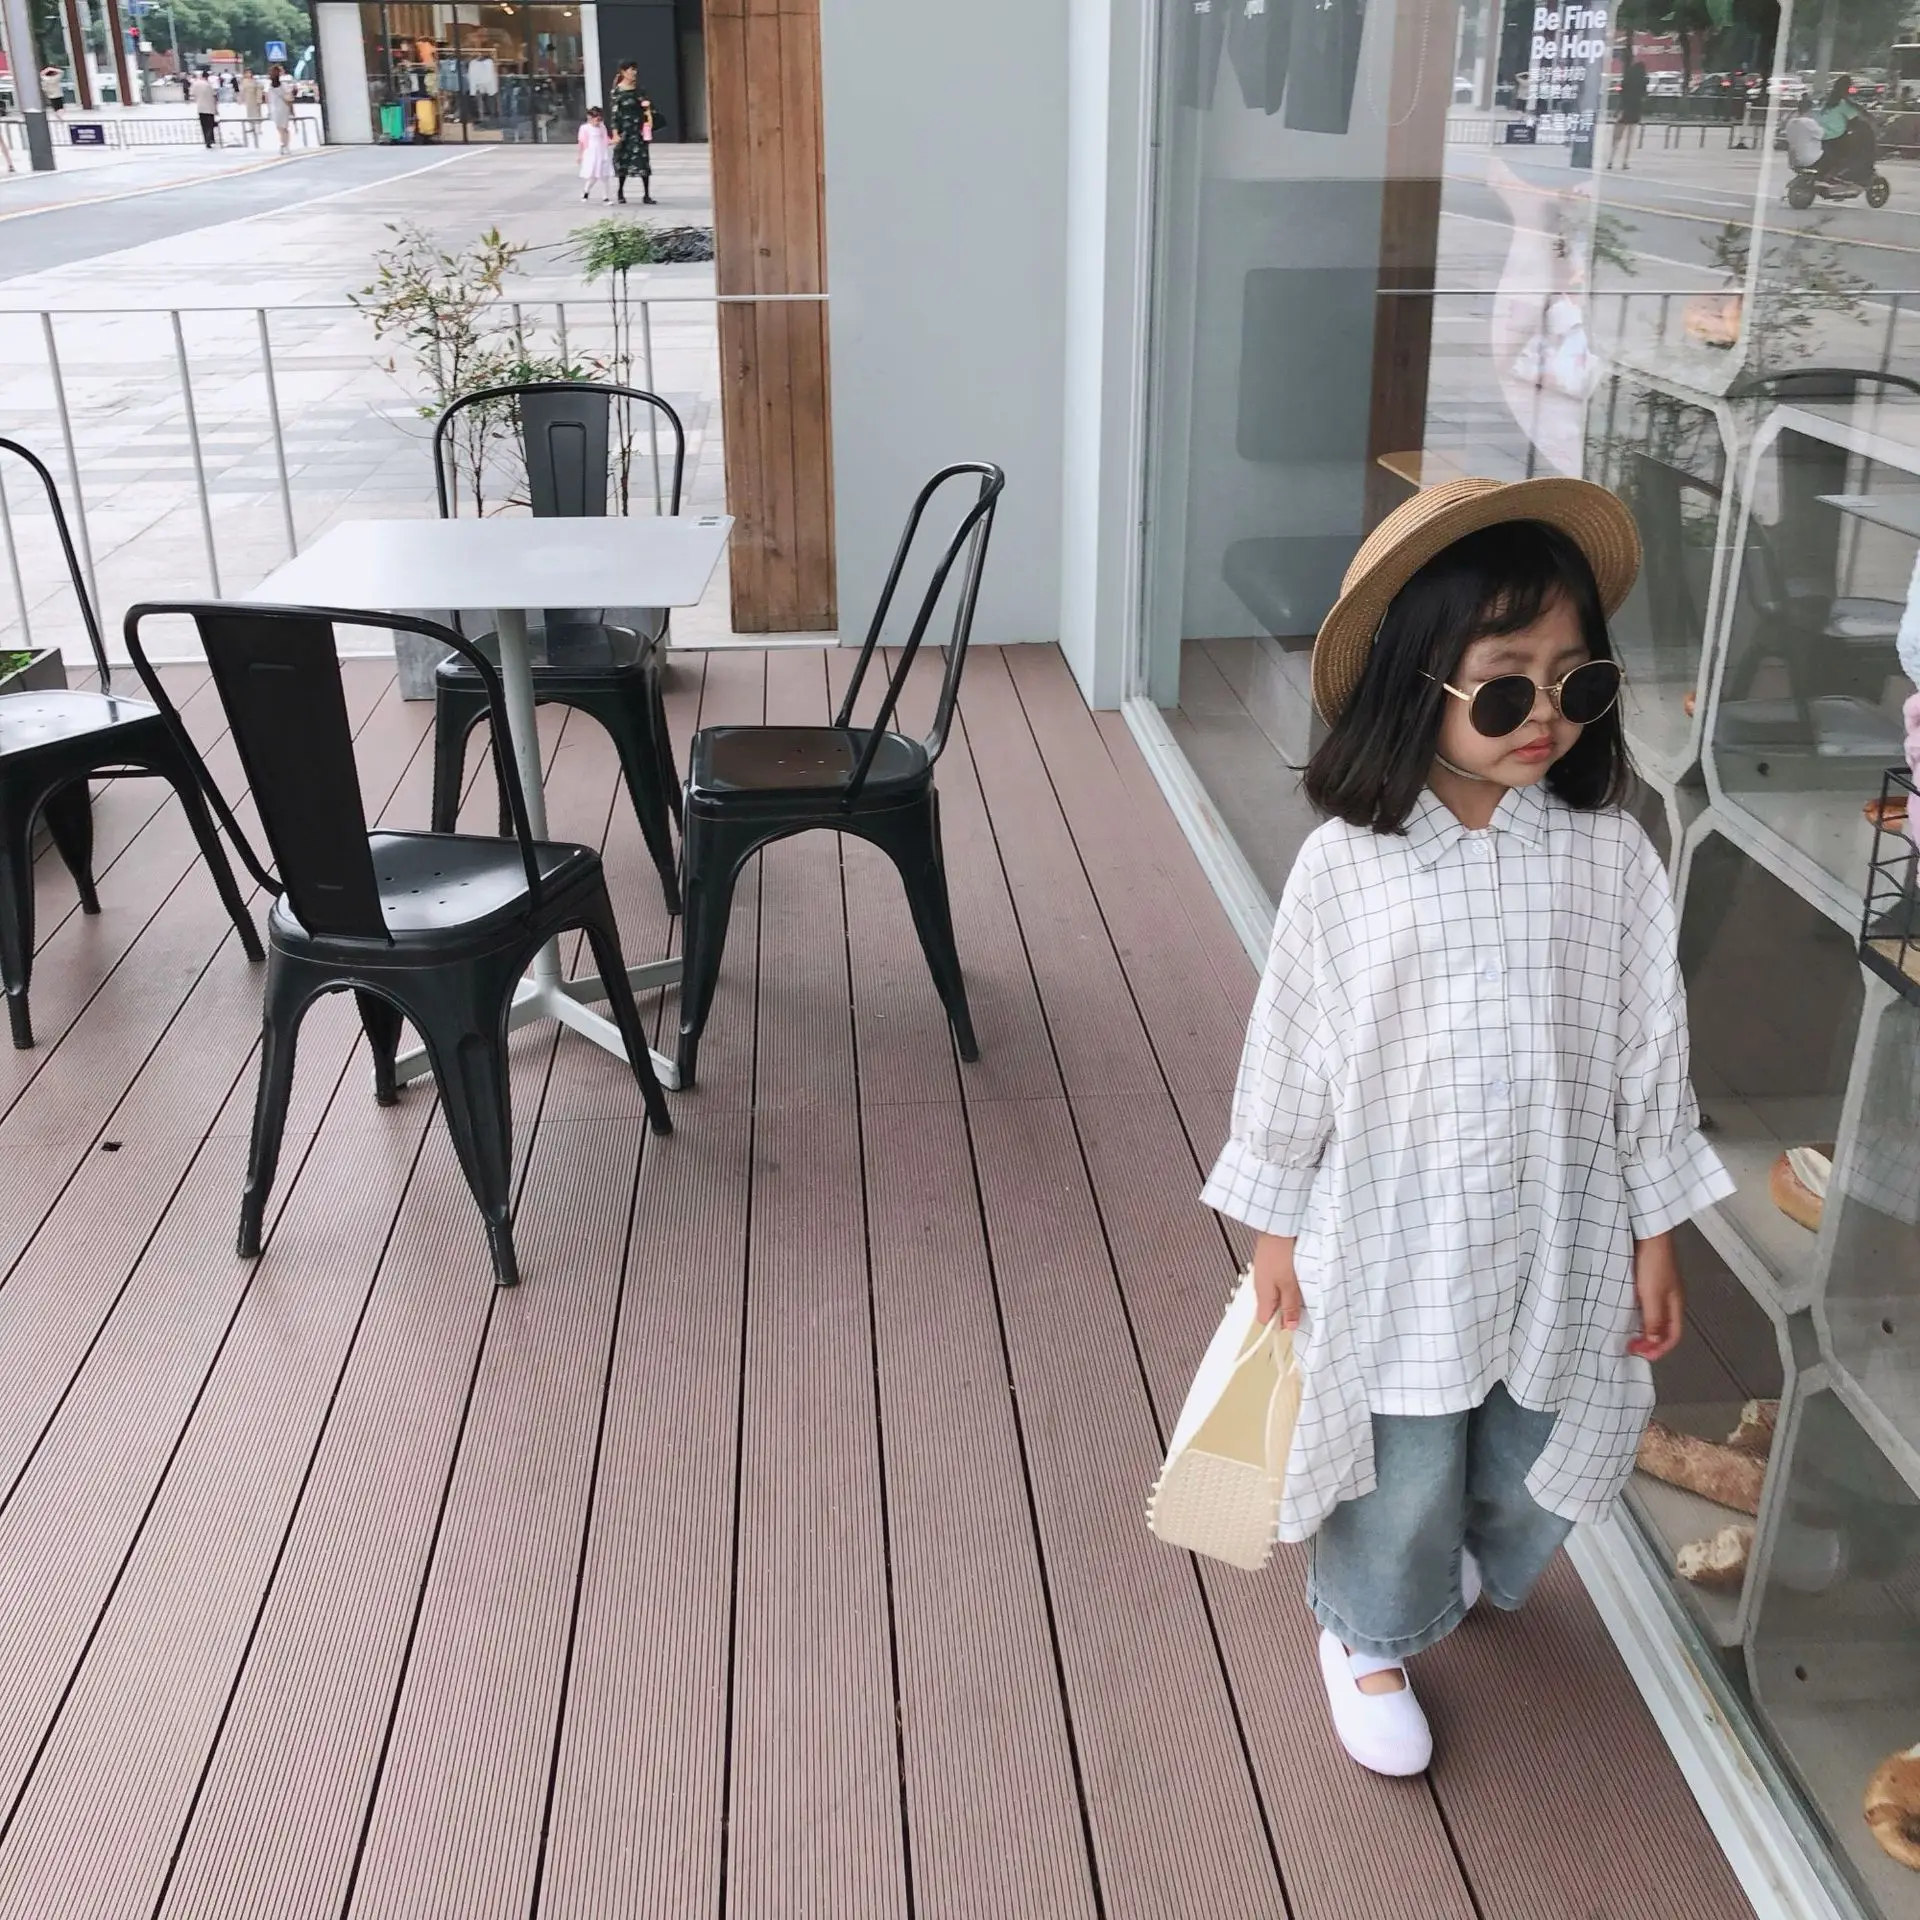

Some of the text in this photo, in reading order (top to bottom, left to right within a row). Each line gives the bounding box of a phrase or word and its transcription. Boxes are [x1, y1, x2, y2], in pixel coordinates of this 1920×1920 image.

[1534, 5, 1608, 31] Be Fine
[1532, 35, 1558, 60] Be
